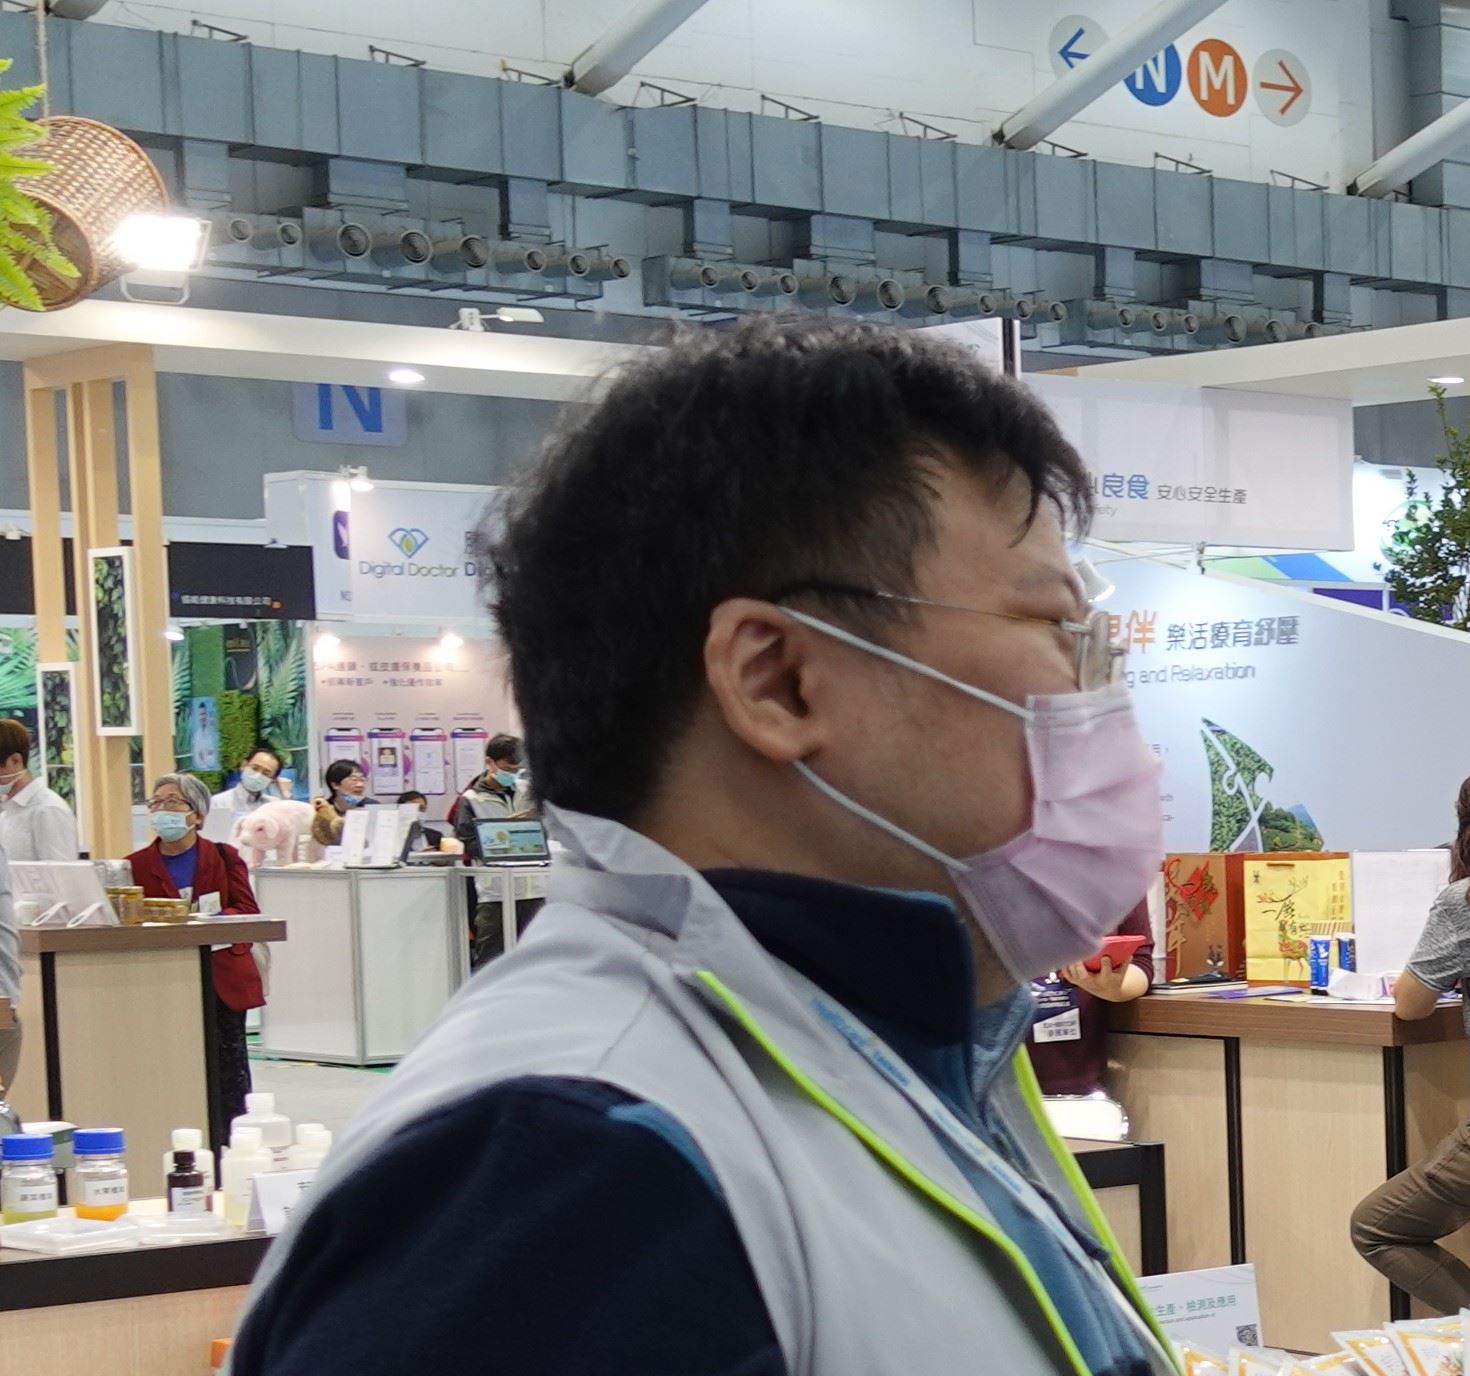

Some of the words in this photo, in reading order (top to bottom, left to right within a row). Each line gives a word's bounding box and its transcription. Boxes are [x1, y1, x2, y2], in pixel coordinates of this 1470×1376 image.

[1136, 41, 1167, 94] N
[1199, 51, 1236, 105] M
[318, 383, 383, 433] N
[1156, 484, 1247, 504] 安心安全生產
[359, 560, 404, 578] Digital
[408, 562, 459, 577] Doctor
[1166, 616, 1300, 651] 樂活療育舒壓
[1140, 667, 1167, 683] and
[1172, 662, 1256, 683] Relaxation
